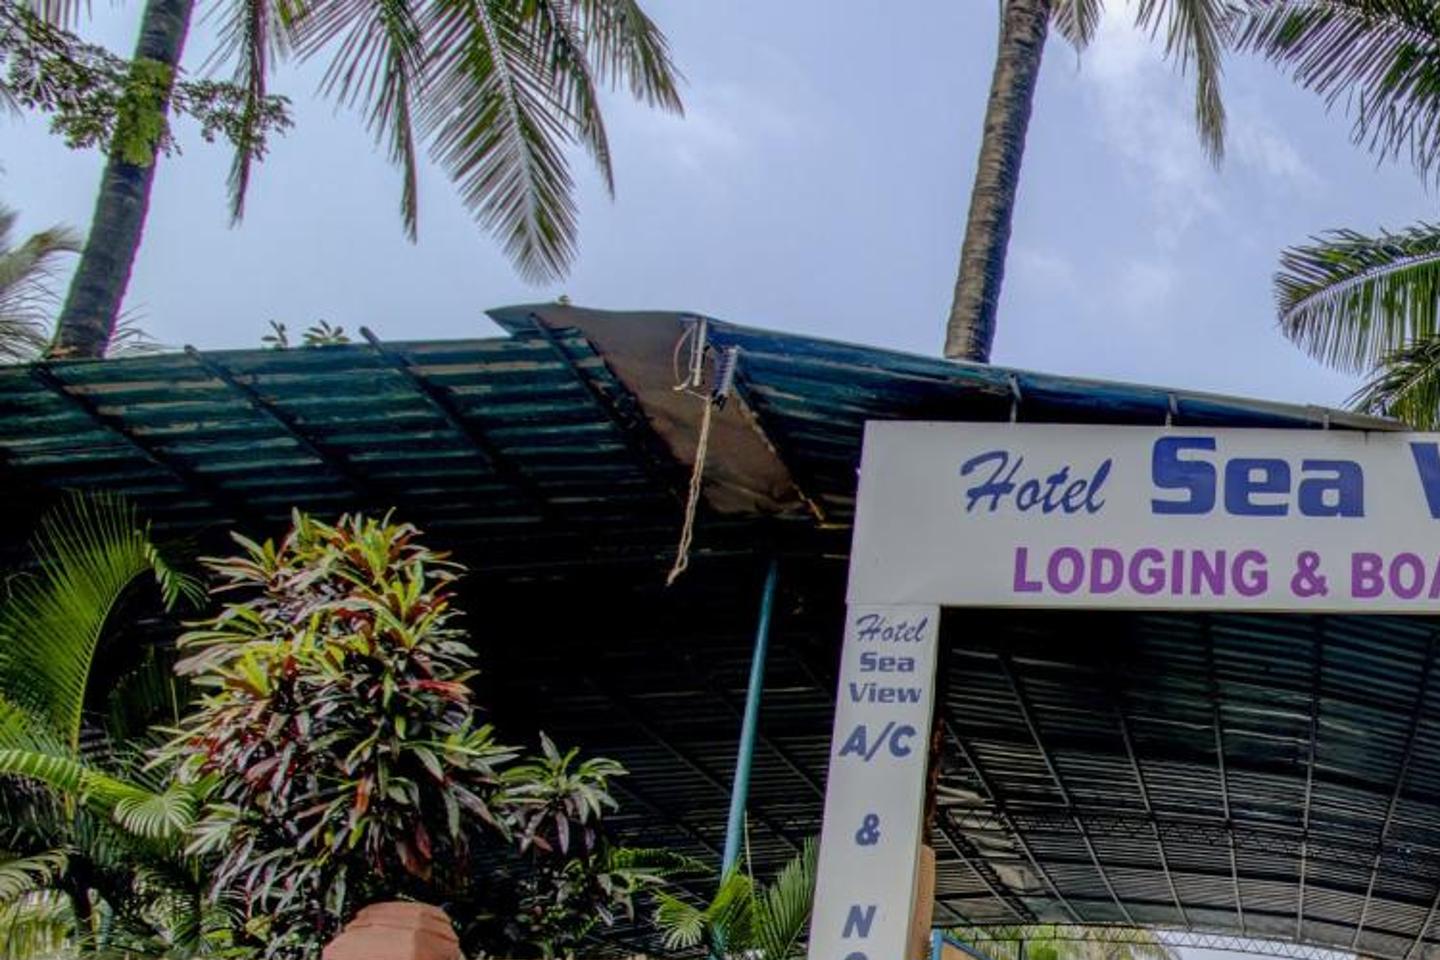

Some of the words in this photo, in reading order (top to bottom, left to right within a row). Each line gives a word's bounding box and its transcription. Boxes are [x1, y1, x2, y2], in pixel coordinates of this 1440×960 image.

[960, 449, 1112, 516] Hotel
[1150, 434, 1366, 520] Sea
[1012, 545, 1269, 599] LODGING
[1290, 551, 1329, 600] &
[854, 613, 928, 643] Hotel
[858, 651, 916, 673] Sea
[848, 682, 922, 704] View
[838, 721, 917, 762] A/C
[855, 813, 881, 847] &
